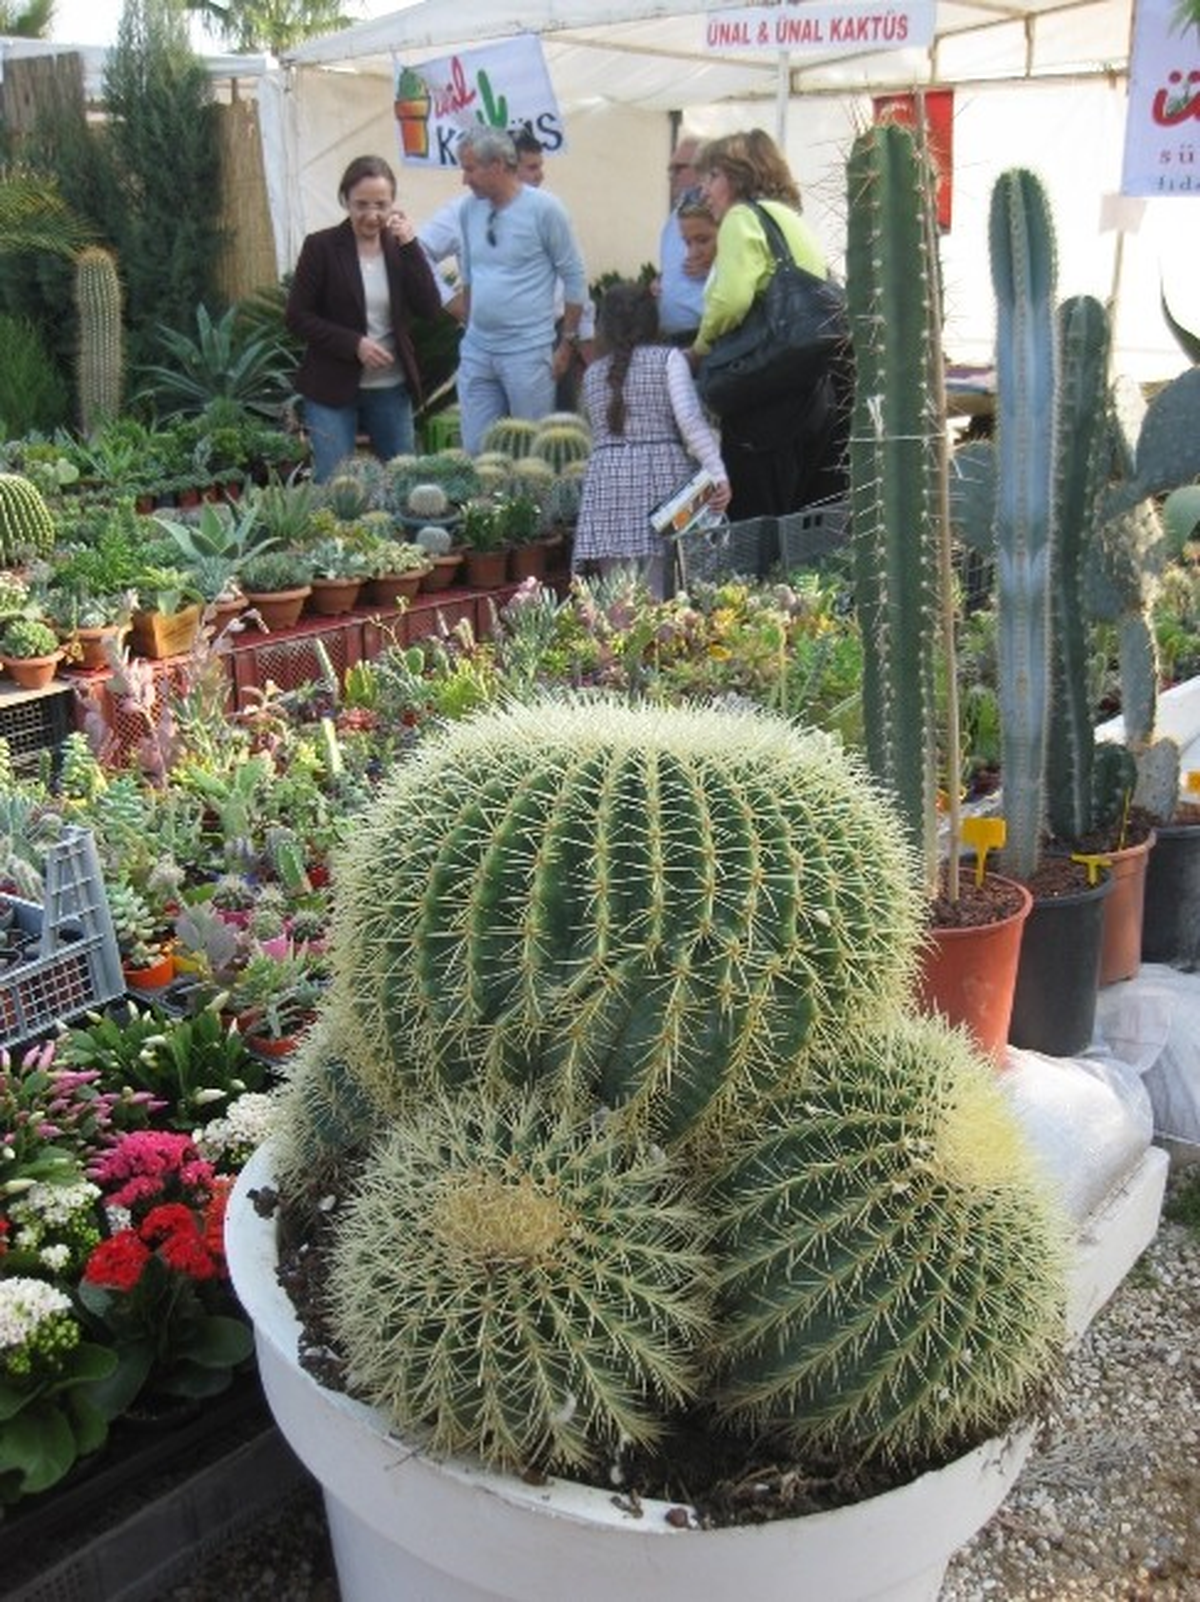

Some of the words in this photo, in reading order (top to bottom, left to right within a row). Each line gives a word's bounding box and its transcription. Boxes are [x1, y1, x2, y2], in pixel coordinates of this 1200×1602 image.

[706, 19, 750, 46] ÜNAL
[757, 21, 769, 44] &
[775, 14, 823, 43] ÜNAL
[829, 10, 909, 41] KAKTÜS
